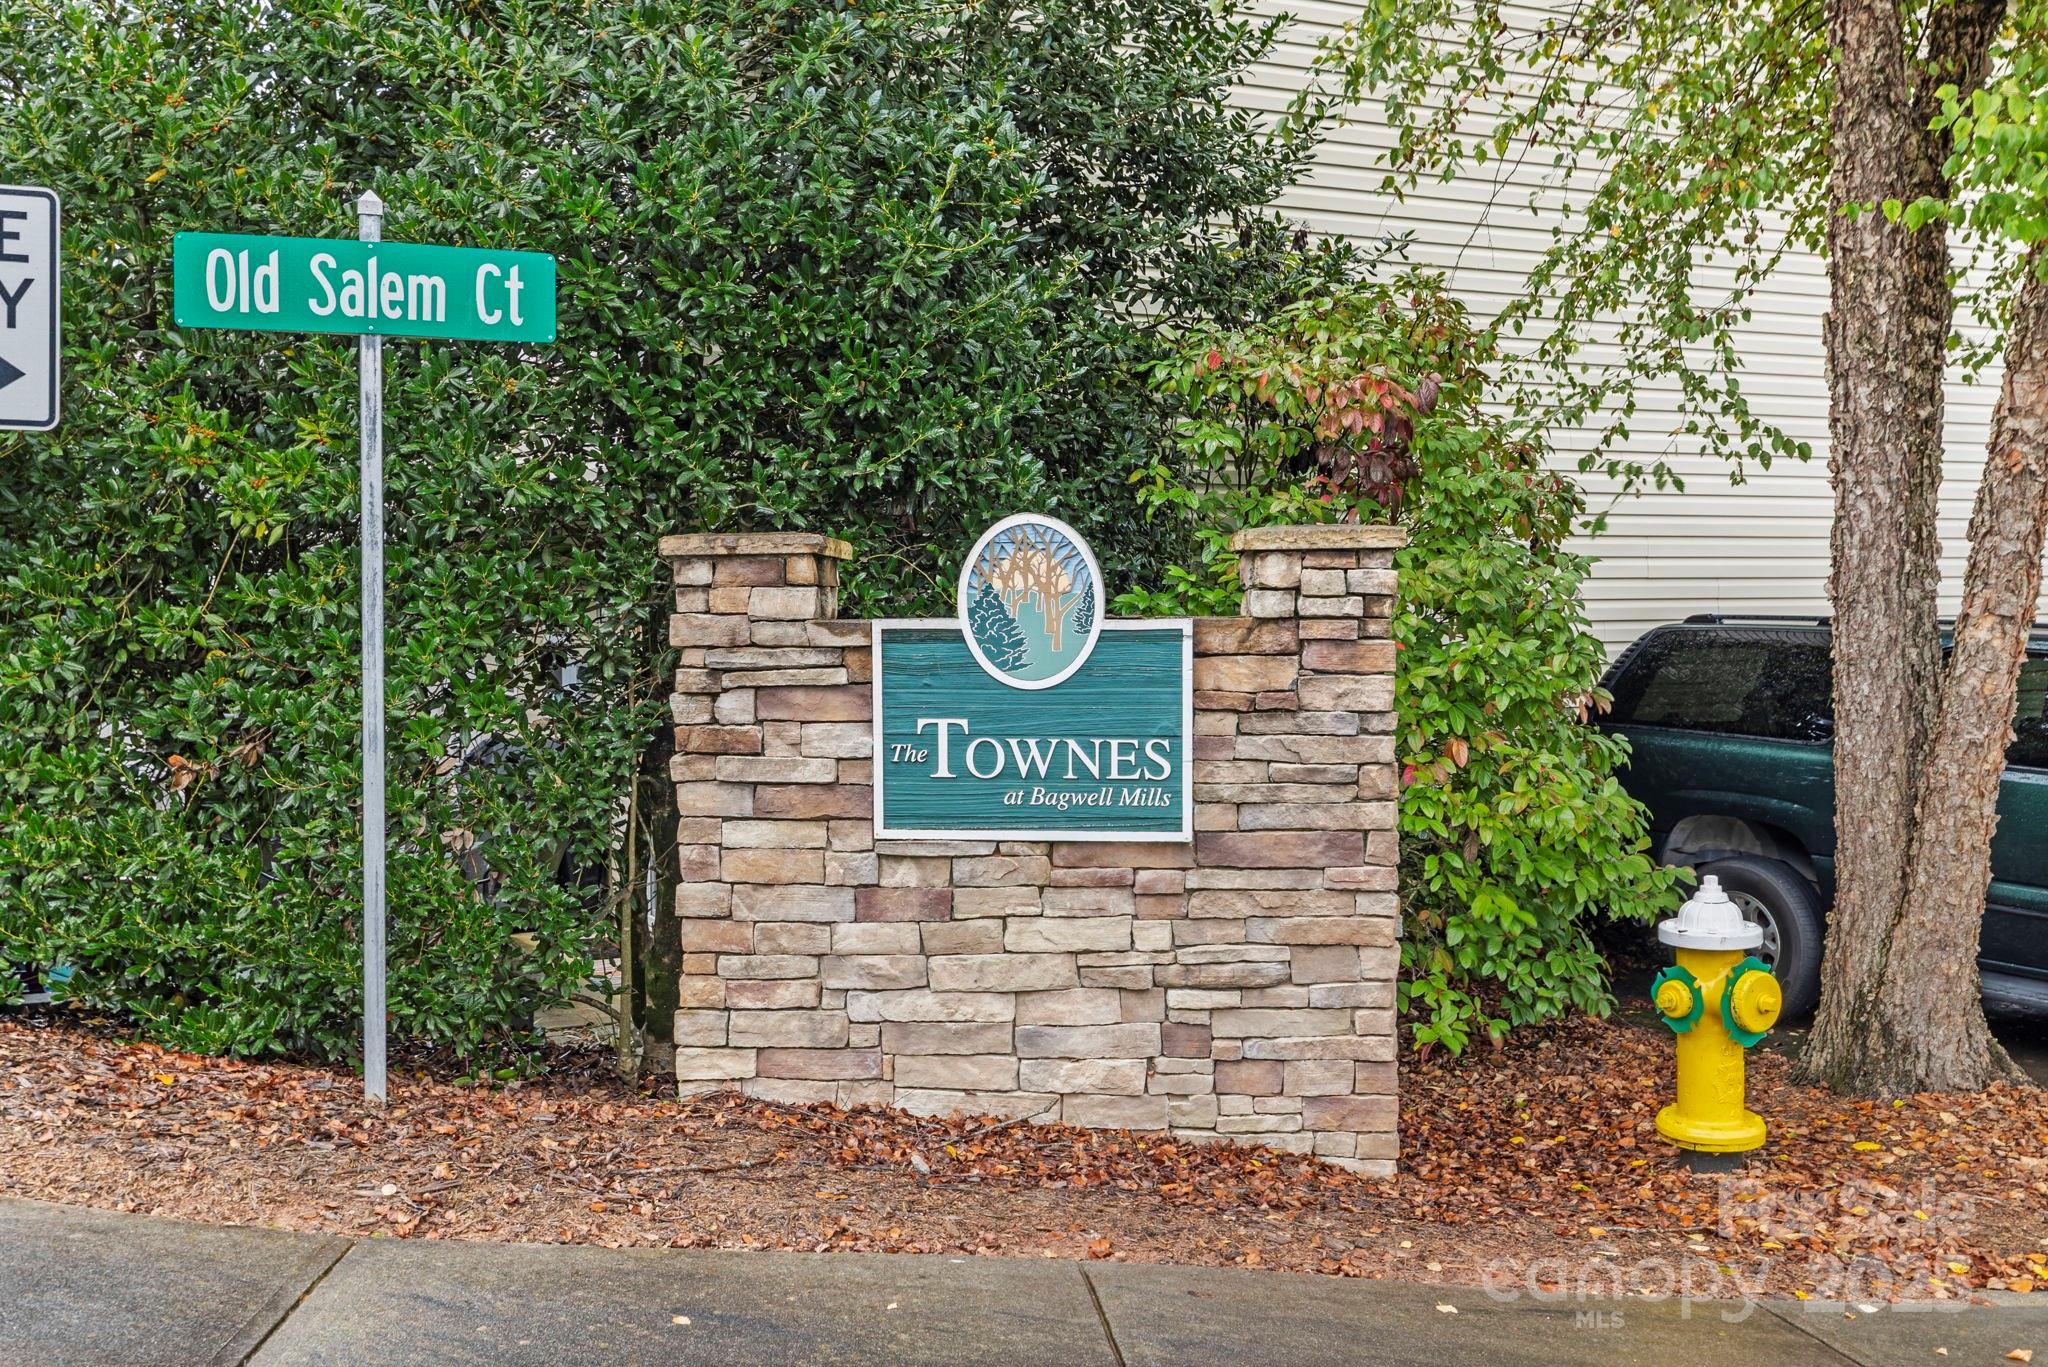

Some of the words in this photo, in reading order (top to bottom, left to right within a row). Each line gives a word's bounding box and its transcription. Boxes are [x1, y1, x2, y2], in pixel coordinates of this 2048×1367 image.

[206, 248, 279, 313] Old
[309, 253, 446, 323] Salem
[476, 263, 525, 326] Ct
[890, 743, 928, 764] The
[917, 718, 1172, 781] TOWNES
[1003, 789, 1025, 806] at
[1029, 786, 1113, 811] Bagwell
[1118, 787, 1173, 807] Mills
